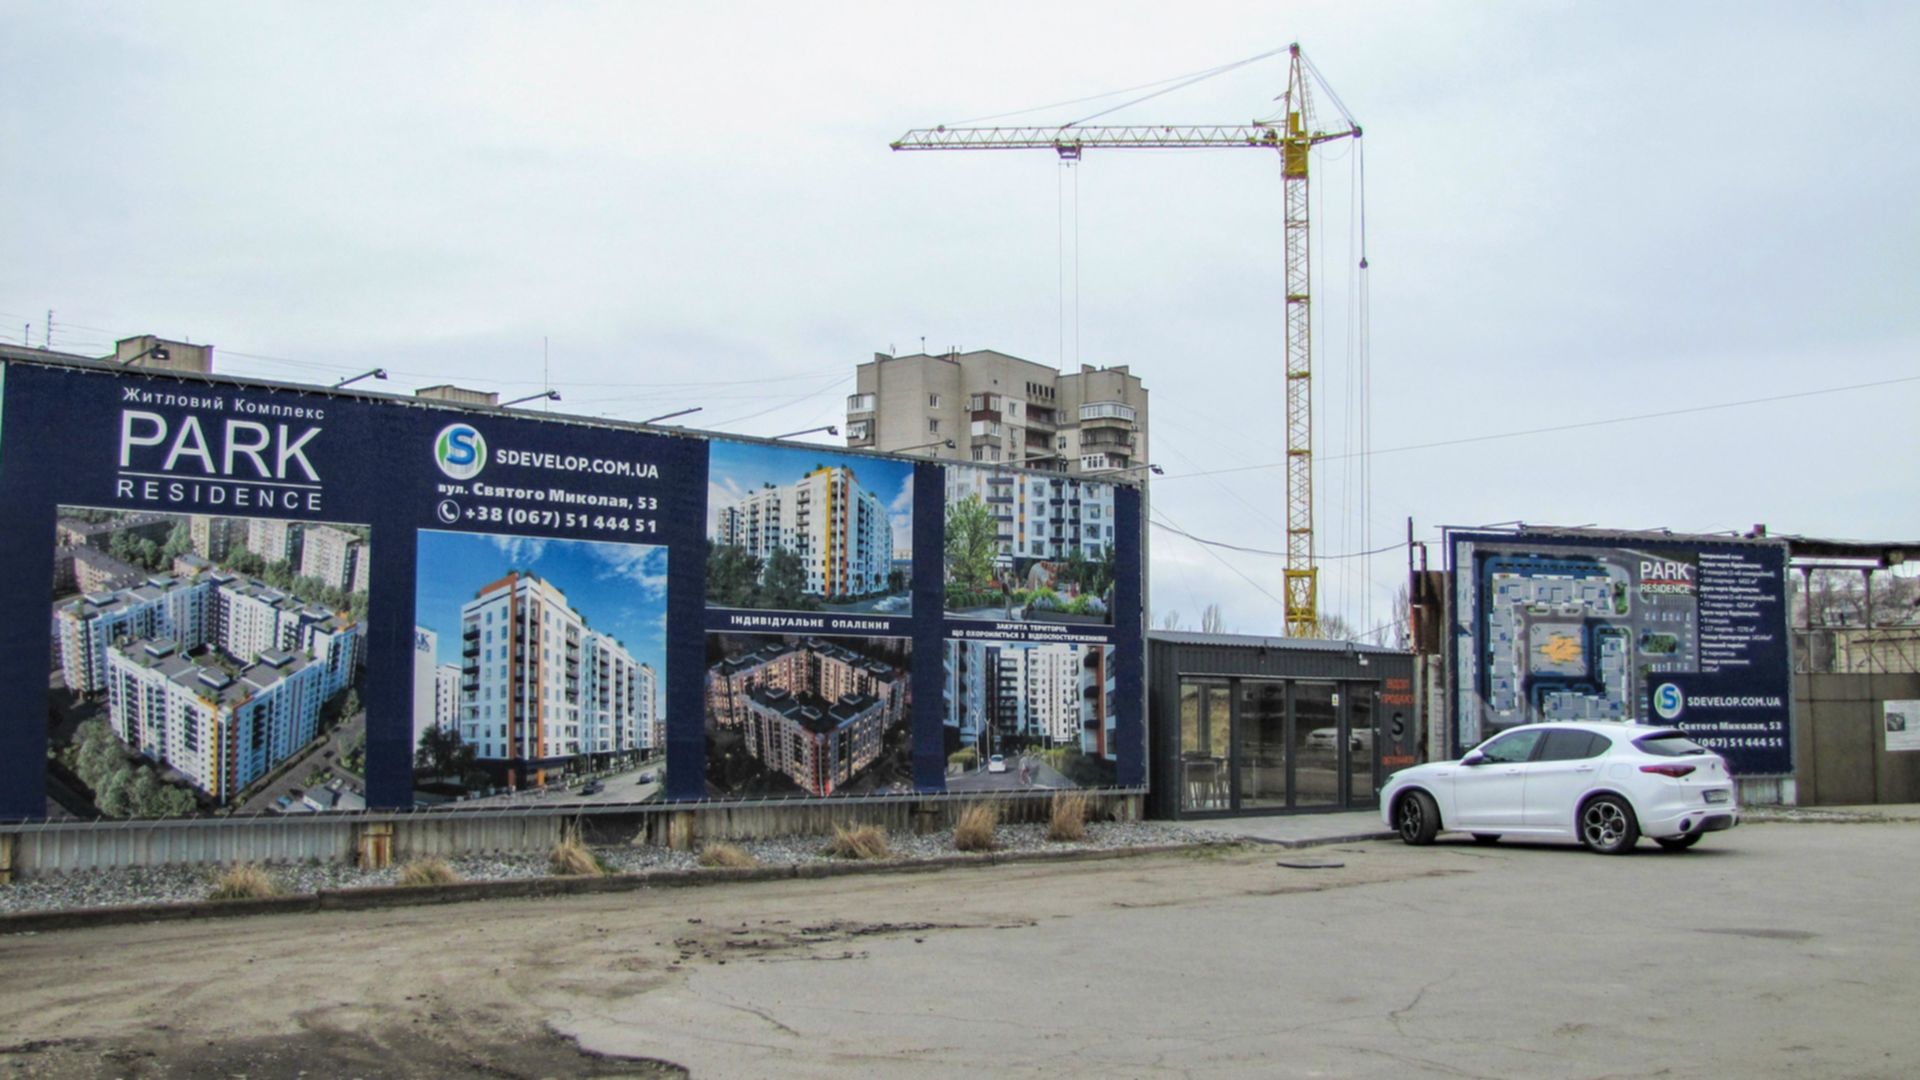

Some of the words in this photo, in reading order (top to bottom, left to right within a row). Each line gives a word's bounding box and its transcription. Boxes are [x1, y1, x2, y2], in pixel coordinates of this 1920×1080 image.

[123, 387, 223, 410] Житловий
[235, 399, 325, 420] Комплекс
[119, 409, 323, 482] PARK
[496, 449, 659, 479] SDEVELOP.COM.UA
[117, 479, 322, 511] RESIDENCE
[438, 483, 469, 496] вул.
[473, 482, 545, 501] Святого
[549, 489, 633, 510] Миколая,
[638, 497, 658, 510] 53
[466, 506, 502, 522] +38
[507, 508, 560, 528] (067)
[1640, 561, 1690, 580] PARK
[1640, 584, 1690, 594] RESIDENCE
[731, 615, 824, 628] ІНДИВІДУАЛЬНЕ
[832, 619, 890, 630] ОПАЛЕННЯ
[996, 623, 1028, 631] ЗАКРИТА
[1687, 697, 1781, 707] SDEVELOP.COM.UA
[1678, 722, 1717, 730] Святого
[1719, 722, 1768, 731] Миколая,
[1769, 722, 1782, 730] 53
